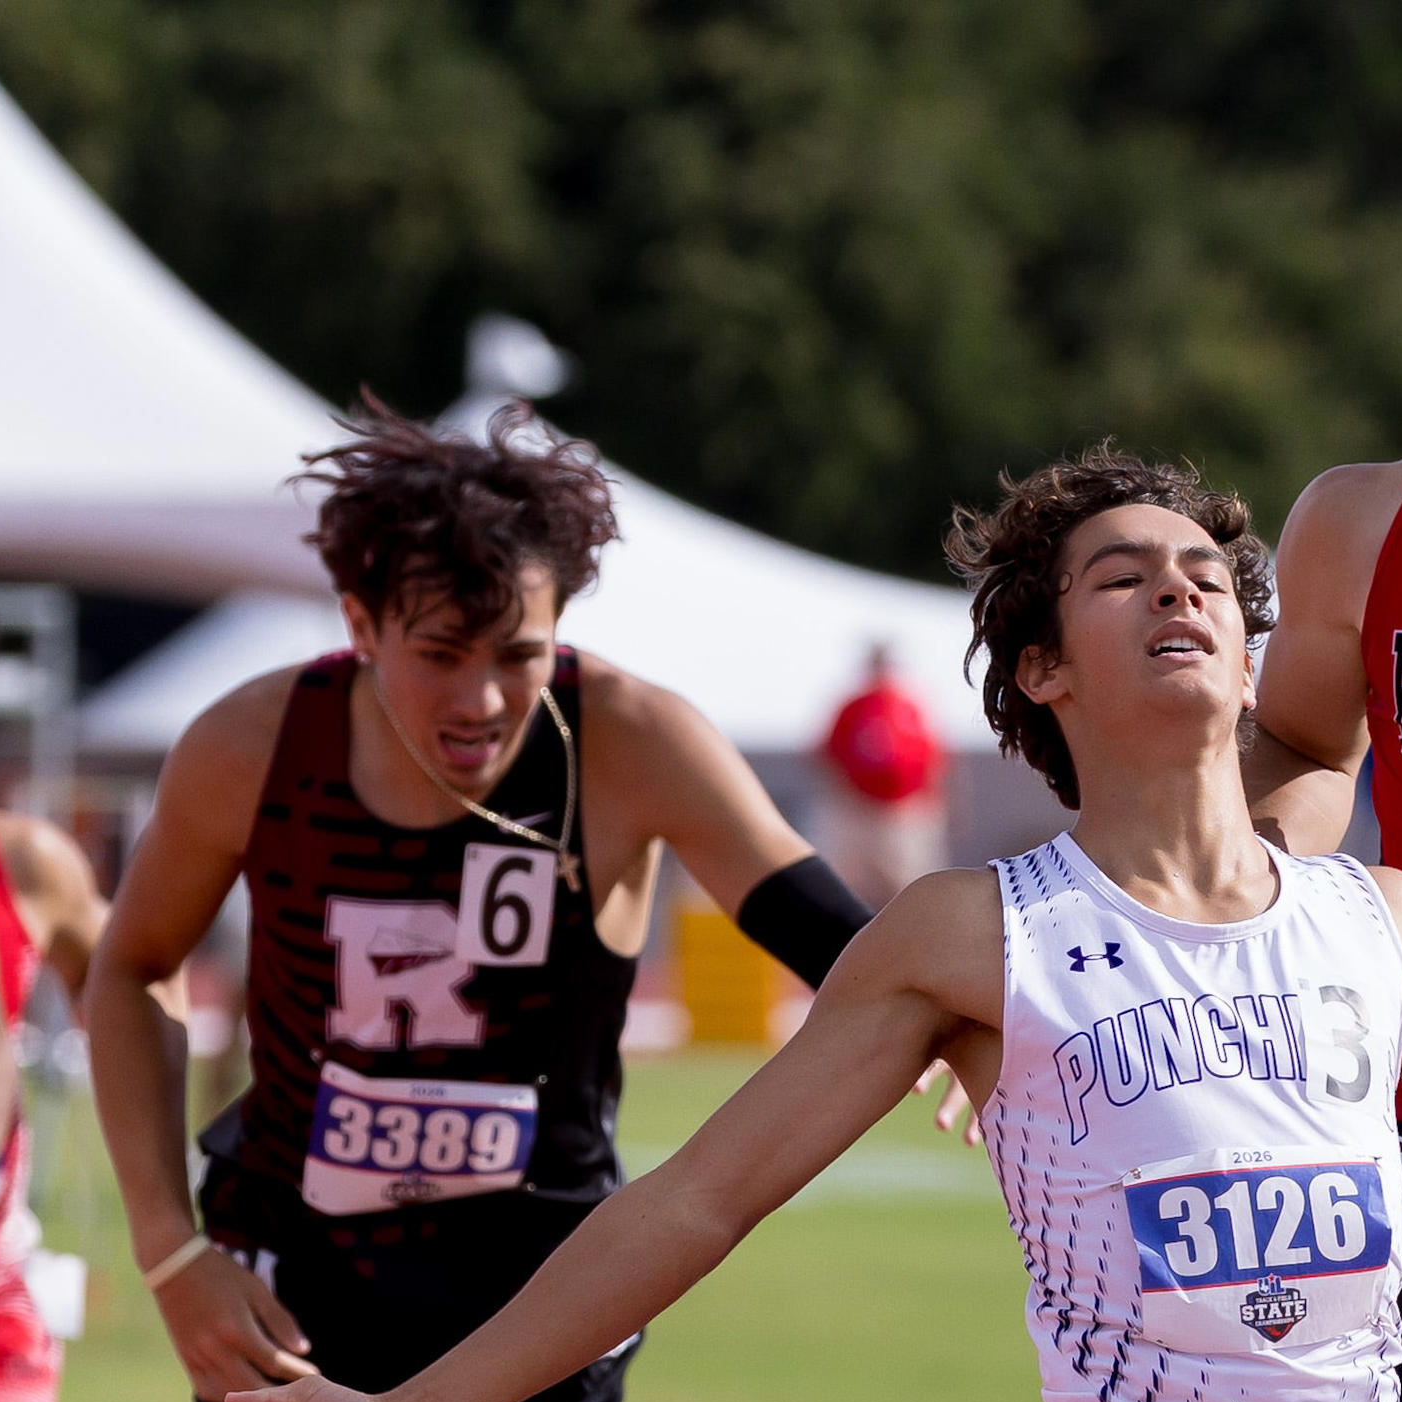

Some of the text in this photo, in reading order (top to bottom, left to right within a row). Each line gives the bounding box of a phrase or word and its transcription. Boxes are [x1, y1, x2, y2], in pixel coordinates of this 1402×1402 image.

[478, 855, 534, 957] 6
[323, 894, 488, 1051] R
[1053, 993, 1306, 1145] PUNCH
[1318, 985, 1372, 1102] 3
[324, 1095, 520, 1172] 3389
[1232, 1150, 1273, 1164] 2026
[1158, 1171, 1367, 1278] 3126
[1241, 1300, 1305, 1321] STATE
